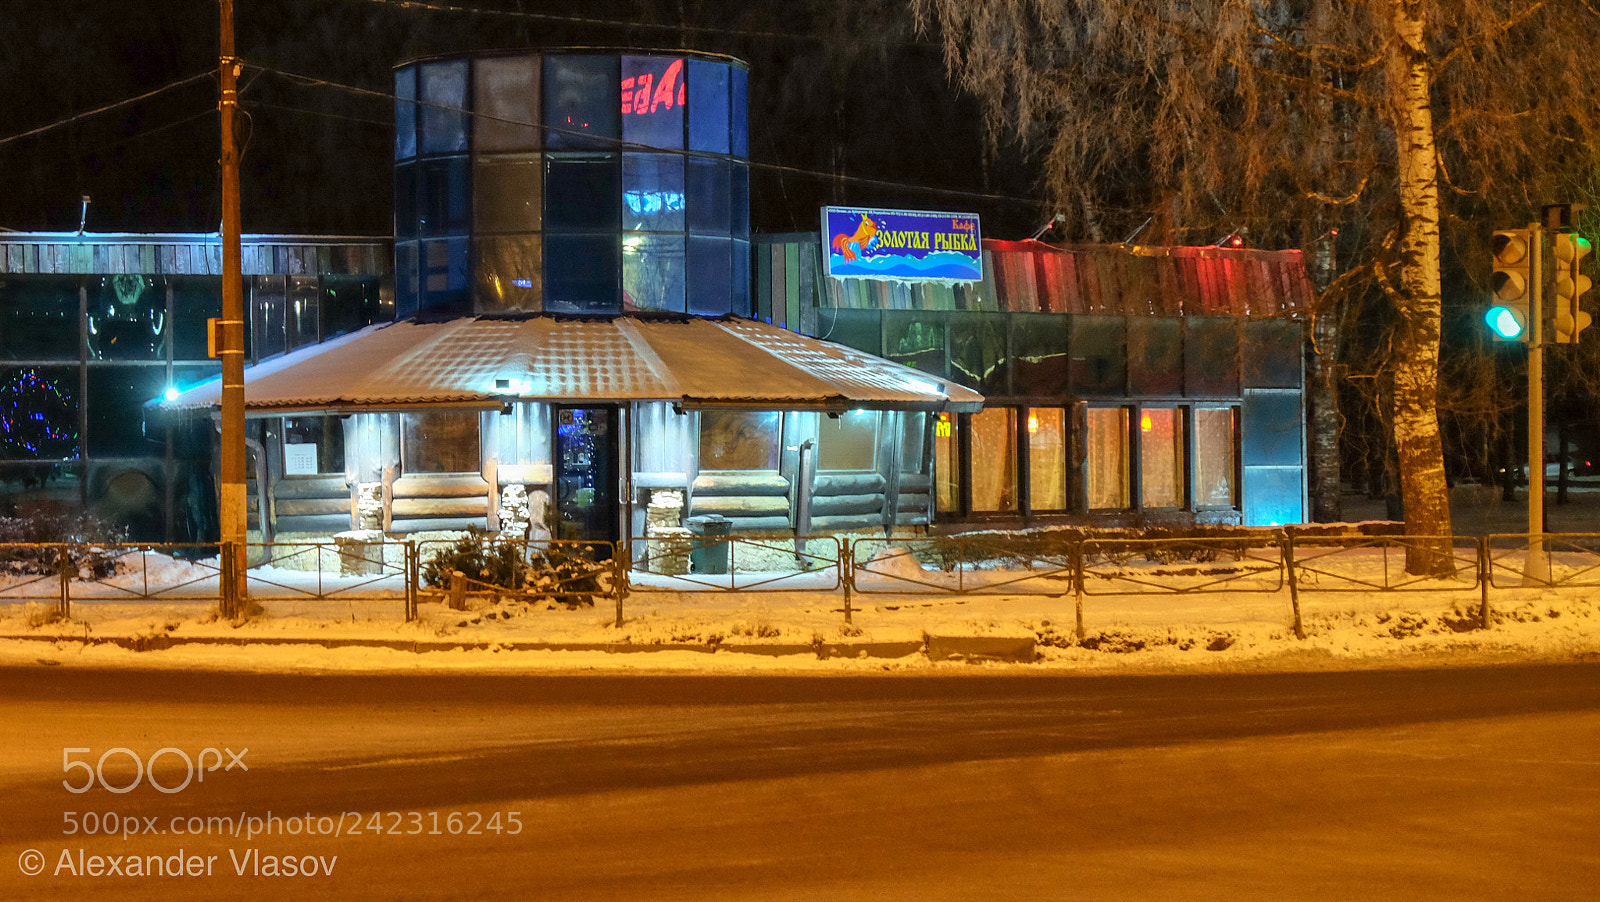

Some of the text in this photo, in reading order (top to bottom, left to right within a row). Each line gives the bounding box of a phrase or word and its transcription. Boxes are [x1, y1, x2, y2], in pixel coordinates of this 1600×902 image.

[952, 219, 976, 232] Кафе
[875, 229, 978, 251] ЗОЛОТАЯ РЫБКА
